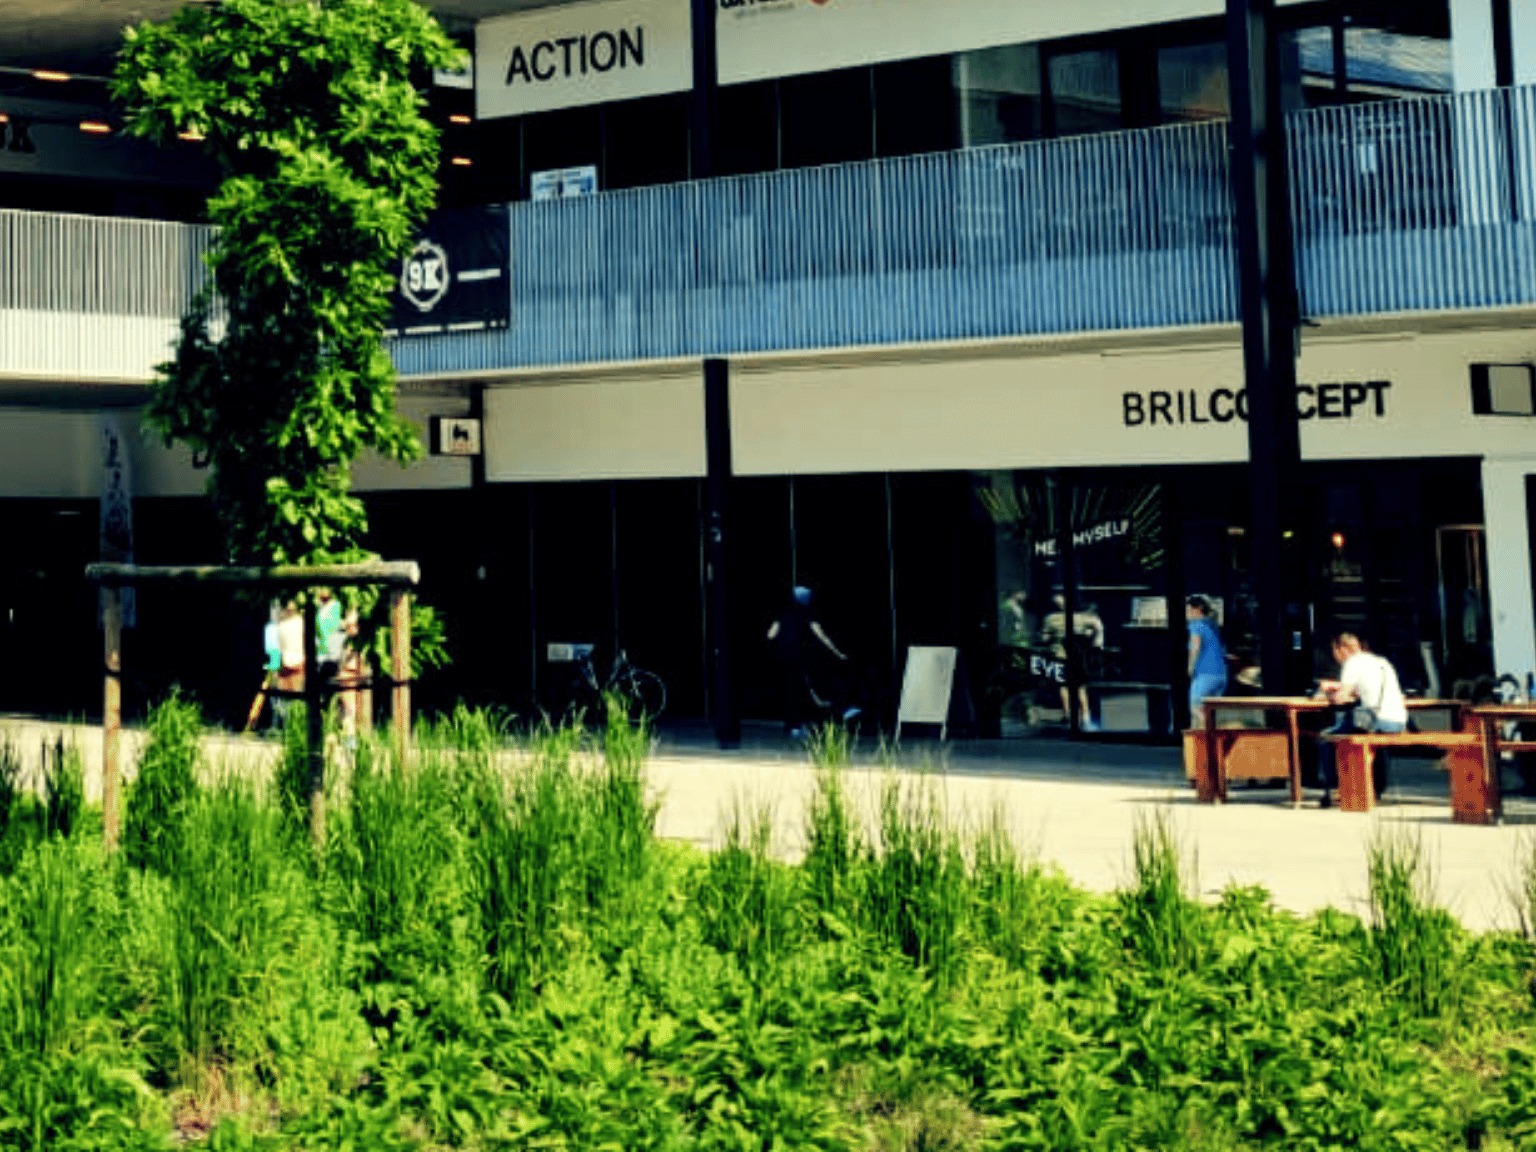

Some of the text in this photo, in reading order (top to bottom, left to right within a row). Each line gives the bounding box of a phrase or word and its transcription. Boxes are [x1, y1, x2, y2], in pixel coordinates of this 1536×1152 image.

[506, 25, 644, 86] ACTION
[1122, 381, 1392, 427] BRILCCEPT
[1072, 519, 1130, 547] MYSELF
